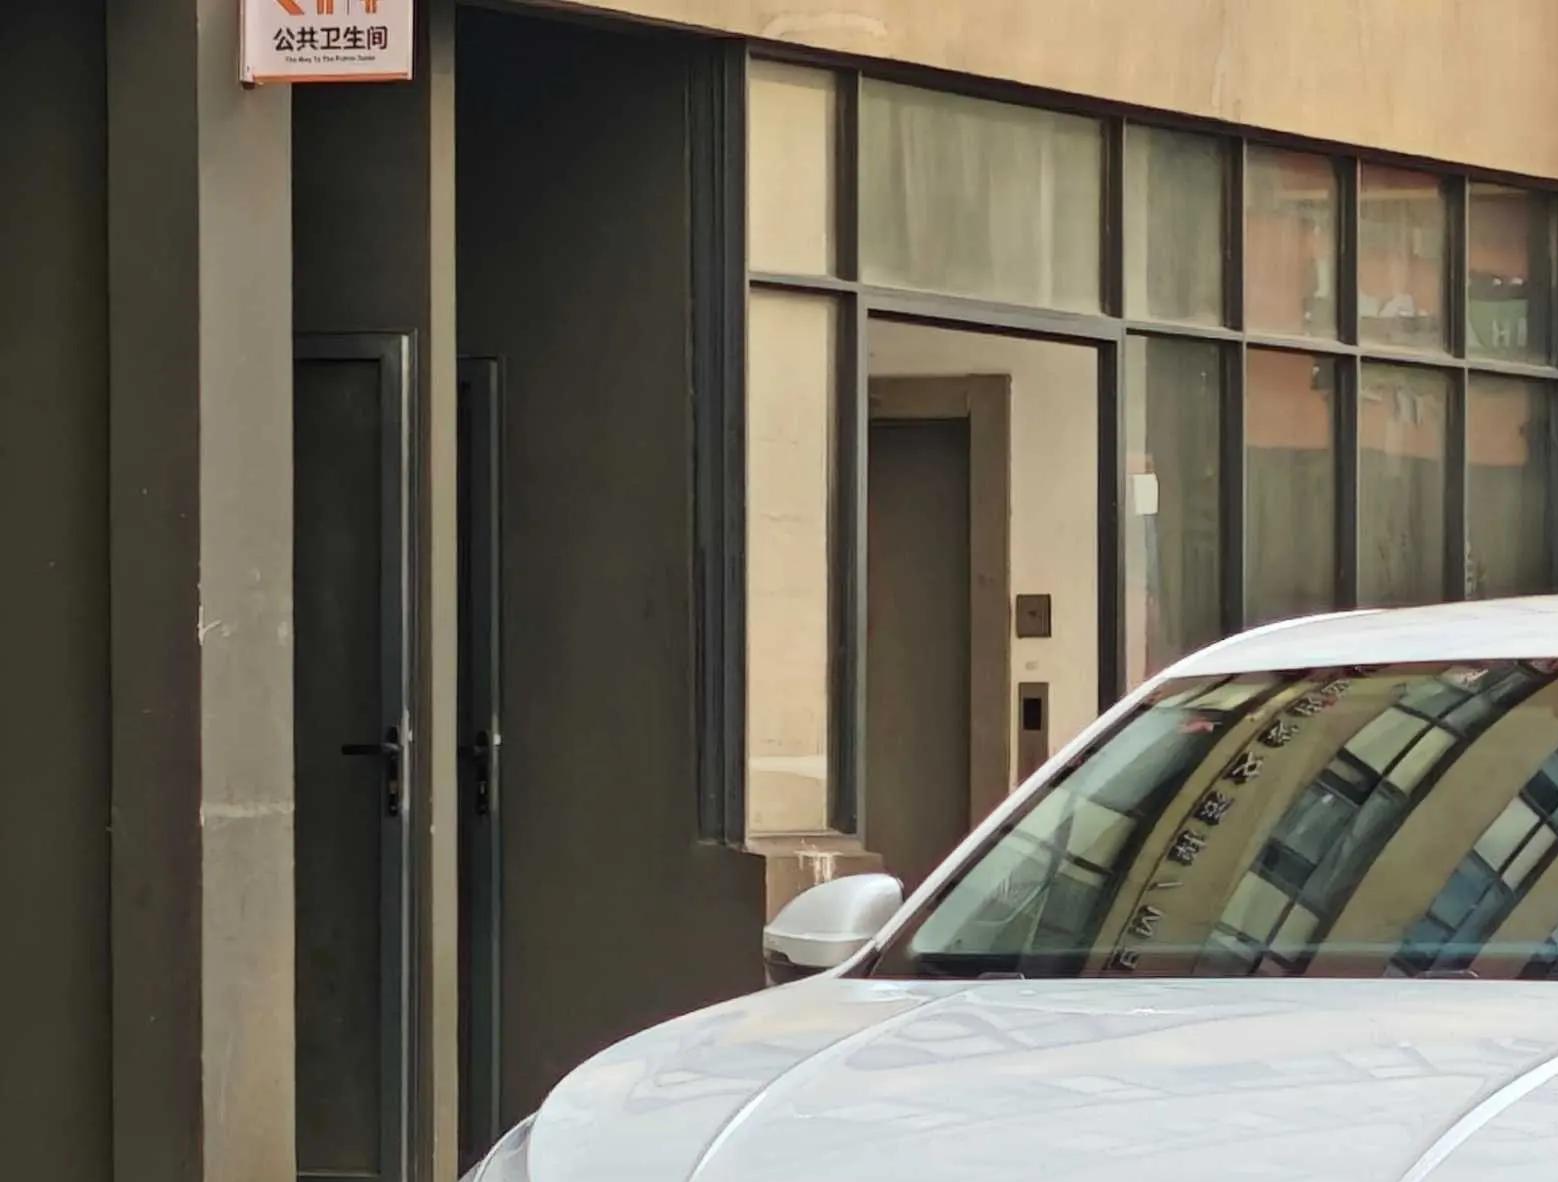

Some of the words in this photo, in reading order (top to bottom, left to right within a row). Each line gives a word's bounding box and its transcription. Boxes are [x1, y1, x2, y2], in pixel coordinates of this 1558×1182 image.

[273, 26, 388, 51] 公共卫生间
